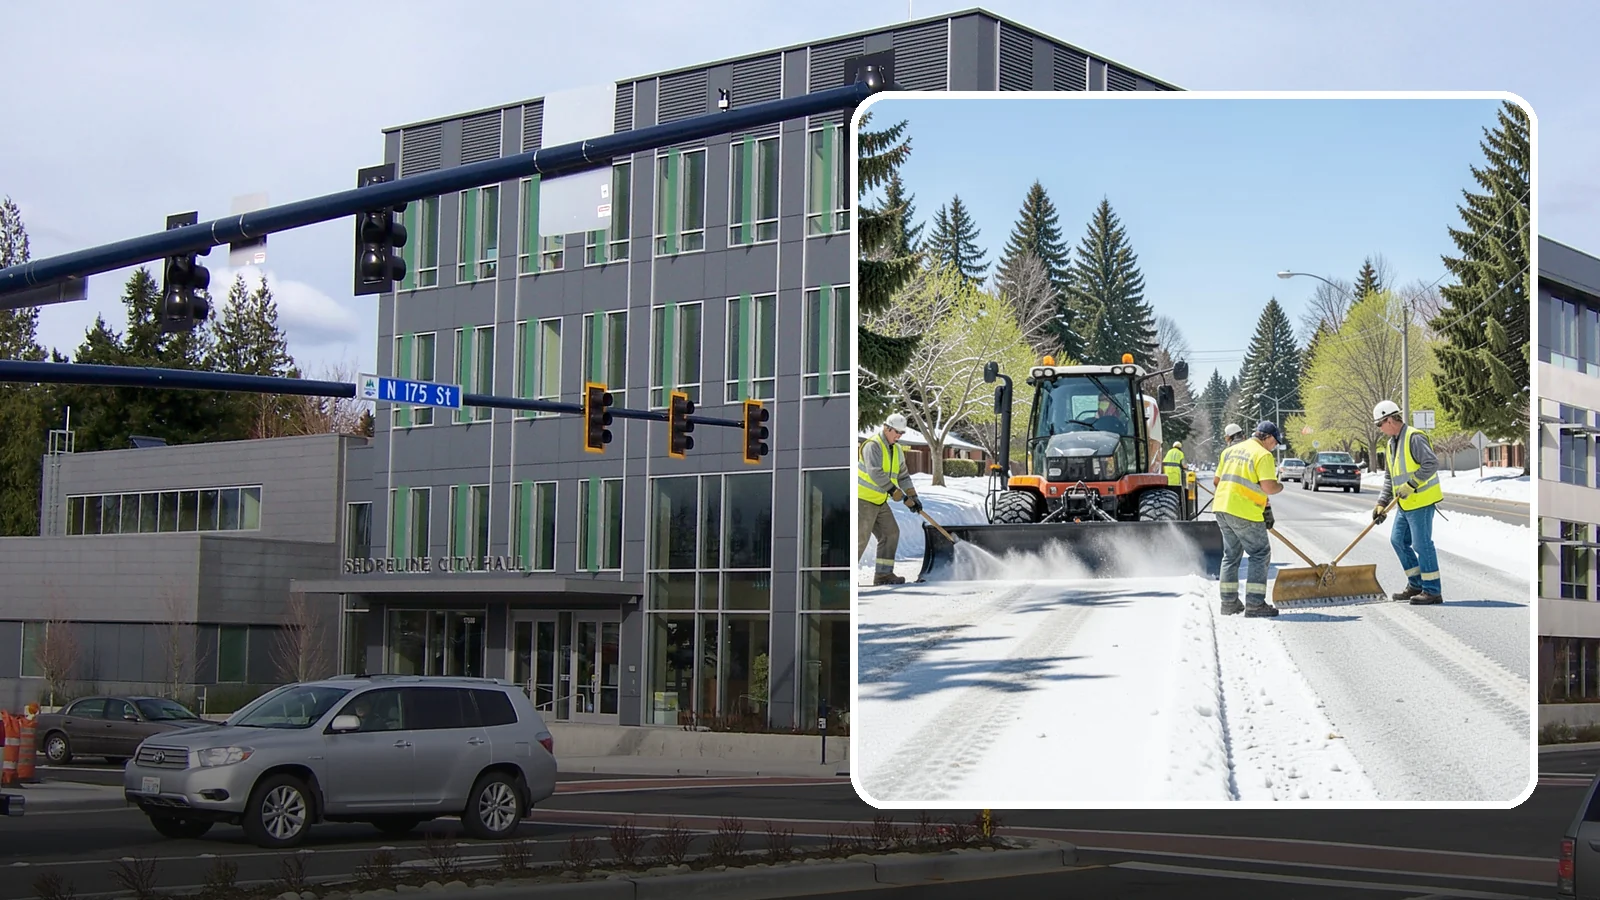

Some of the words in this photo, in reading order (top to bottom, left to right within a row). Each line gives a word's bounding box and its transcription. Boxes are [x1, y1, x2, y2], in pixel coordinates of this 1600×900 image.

[387, 380, 396, 399] N
[405, 382, 427, 403] 175
[436, 386, 451, 406] St
[344, 556, 432, 574] SHORELINE
[438, 556, 476, 573] CITY
[484, 555, 526, 572] HALL
